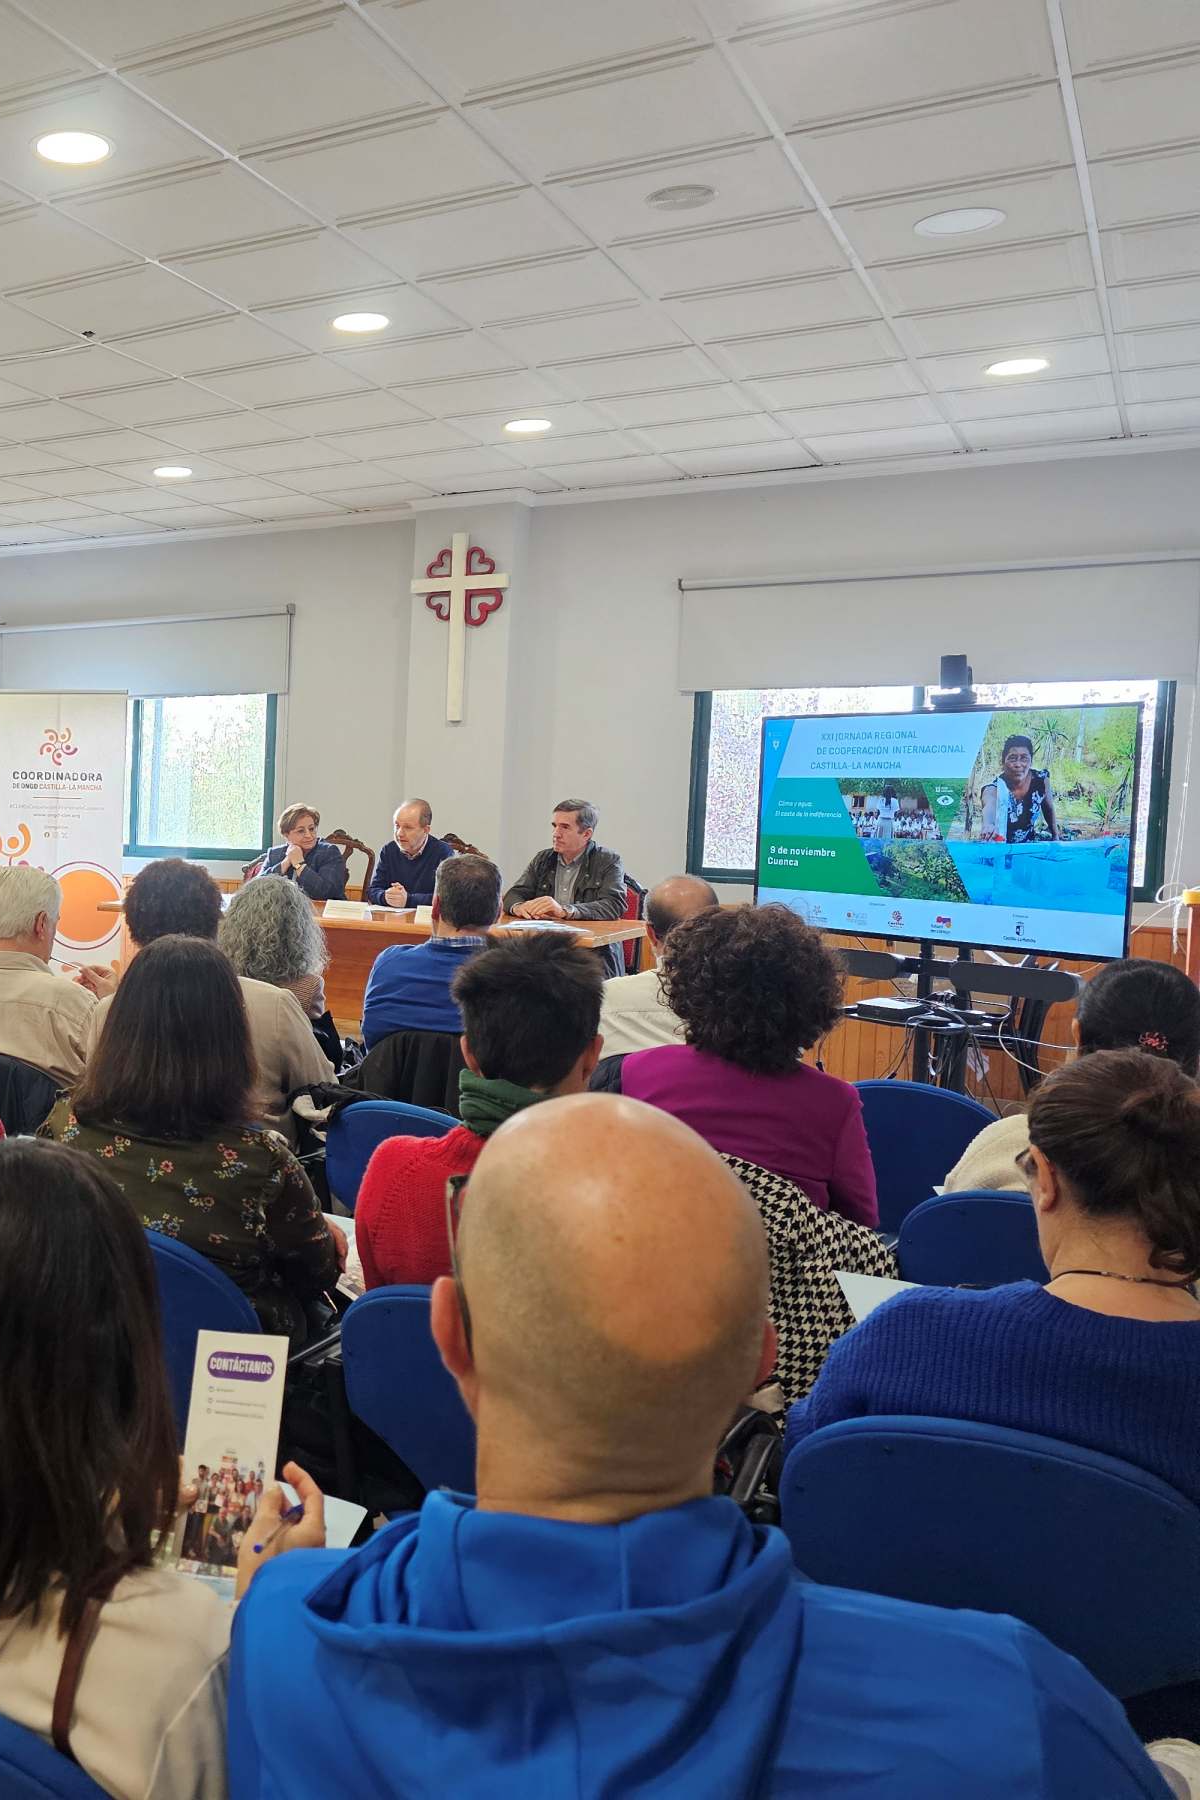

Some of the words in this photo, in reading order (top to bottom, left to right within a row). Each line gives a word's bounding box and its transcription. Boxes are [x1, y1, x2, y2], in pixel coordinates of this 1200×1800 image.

[834, 731, 873, 742] JORNADA
[875, 730, 918, 740] REGIONAL
[816, 746, 827, 756] DE
[892, 744, 966, 754] INTERNACIONAL
[810, 761, 862, 770] CASTILLA-LA
[863, 761, 902, 770] MANCHA
[12, 770, 104, 782] COORDINADORA
[12, 782, 20, 790] DE
[39, 783, 77, 791] CASTILLA-LA
[77, 784, 103, 792] MANCHA
[777, 846, 788, 855] de
[790, 847, 836, 857] noviembre
[767, 856, 799, 867] Cuenca
[210, 1356, 273, 1375] CONTÁCTANOS
